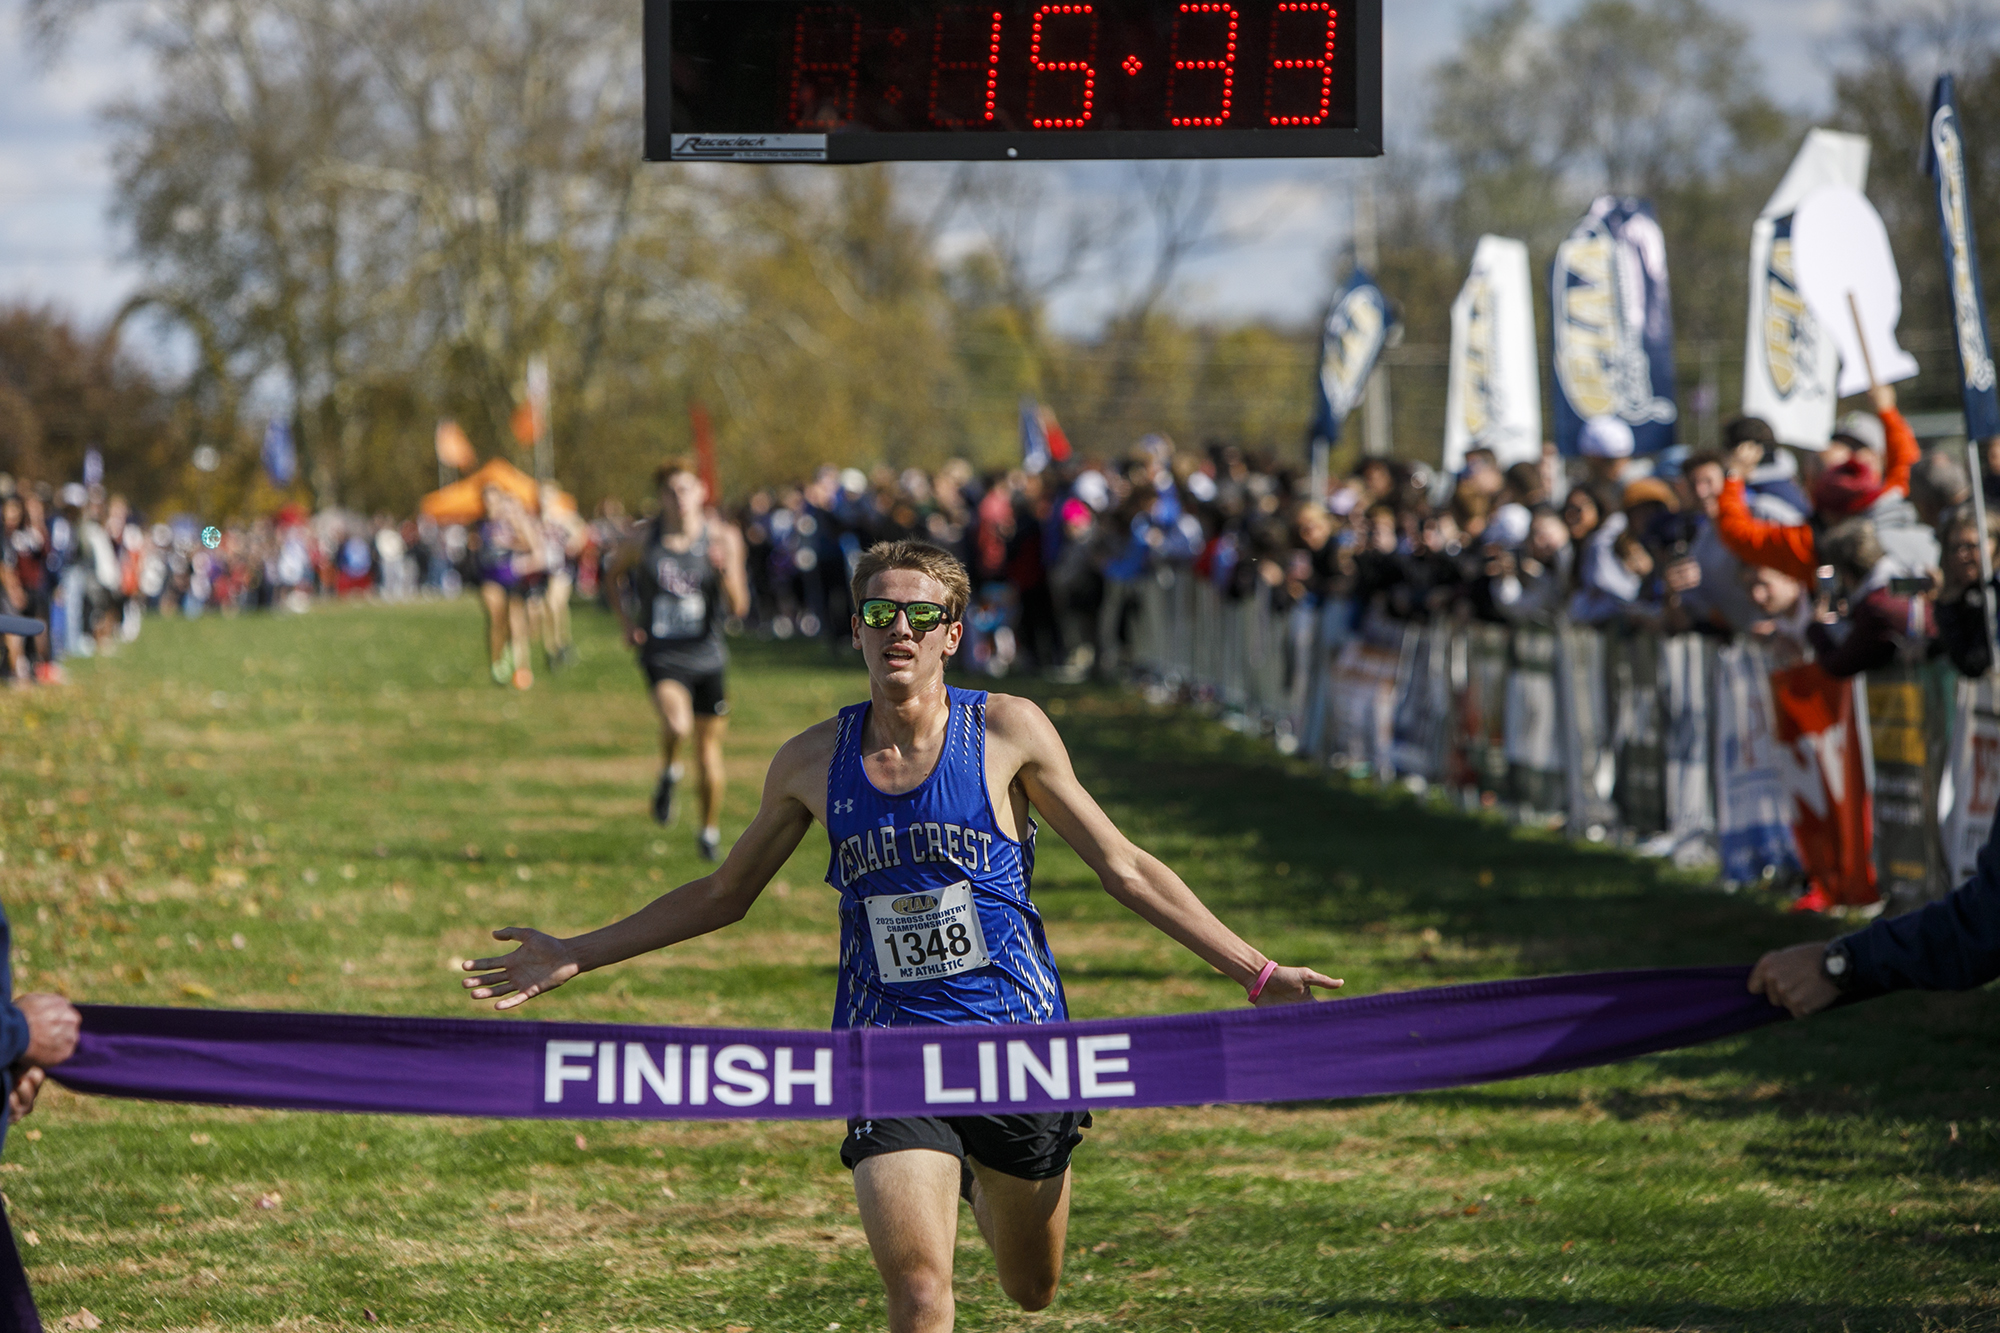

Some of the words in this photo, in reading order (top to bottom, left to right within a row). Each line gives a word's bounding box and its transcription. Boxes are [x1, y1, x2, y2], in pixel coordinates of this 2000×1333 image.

[674, 136, 766, 151] Raceclock
[839, 826, 901, 887] CEDAR
[909, 822, 992, 872] CREST
[899, 895, 935, 912] PIAA
[875, 917, 894, 925] 2025
[896, 915, 924, 924] CROSS
[926, 904, 967, 921] COUNTRY
[886, 915, 957, 933] CHAMPIONSHIPS
[884, 922, 971, 967] 1348
[915, 958, 964, 977] ATHLETIC
[543, 1039, 833, 1106] FINISH
[922, 1033, 1136, 1104] LINE
